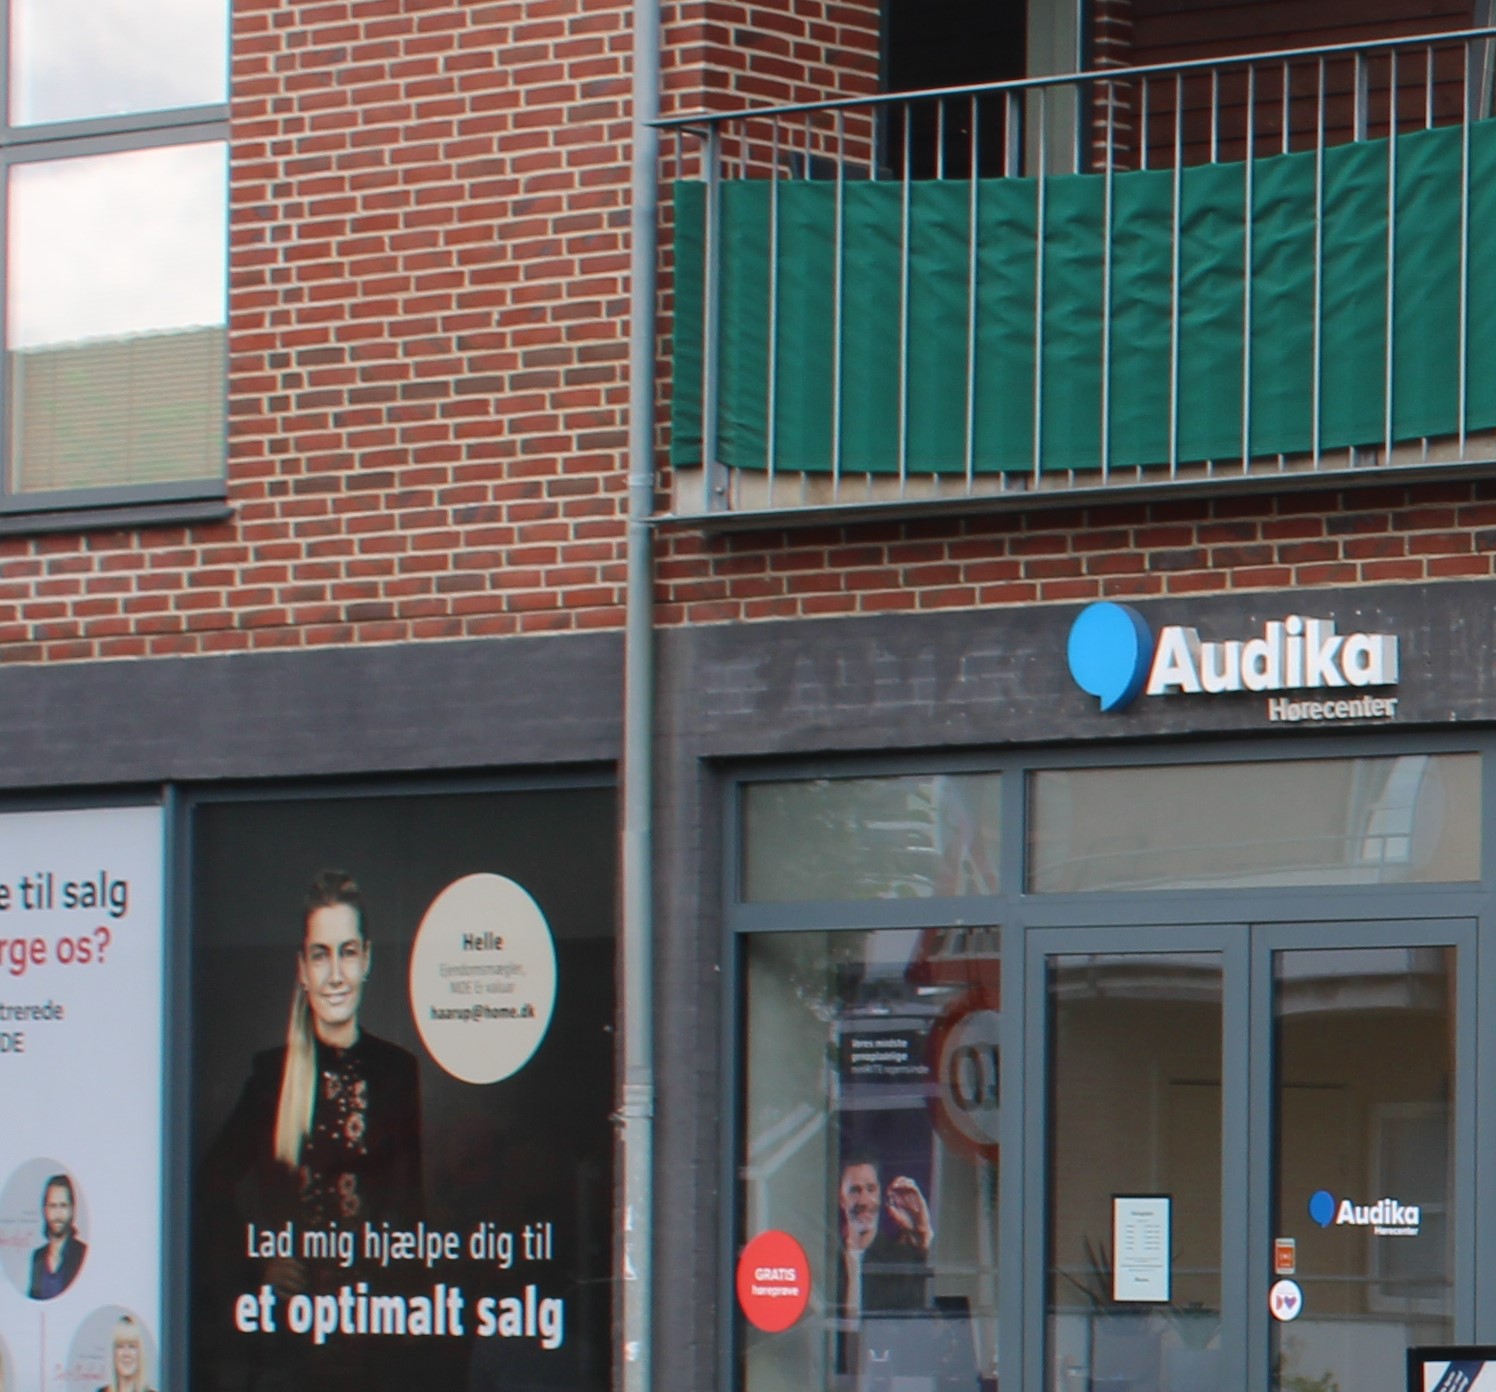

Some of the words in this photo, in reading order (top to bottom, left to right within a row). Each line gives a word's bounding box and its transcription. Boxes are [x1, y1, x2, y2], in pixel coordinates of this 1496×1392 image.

[1146, 615, 1398, 696] Audika
[1269, 696, 1398, 721] Hørecenter
[20, 872, 53, 909] til
[63, 870, 128, 918] salg
[56, 926, 111, 964] os?
[463, 932, 503, 950] Helle
[1336, 1199, 1420, 1225] Audika
[247, 1222, 293, 1258] Lad
[303, 1222, 354, 1267] mig
[364, 1222, 459, 1268] hjælpe
[470, 1222, 513, 1269] dig
[522, 1222, 552, 1260] til
[755, 1267, 796, 1281] GRATIS
[234, 1284, 276, 1333] et
[287, 1282, 464, 1345] optimalt
[476, 1284, 564, 1349] salg
